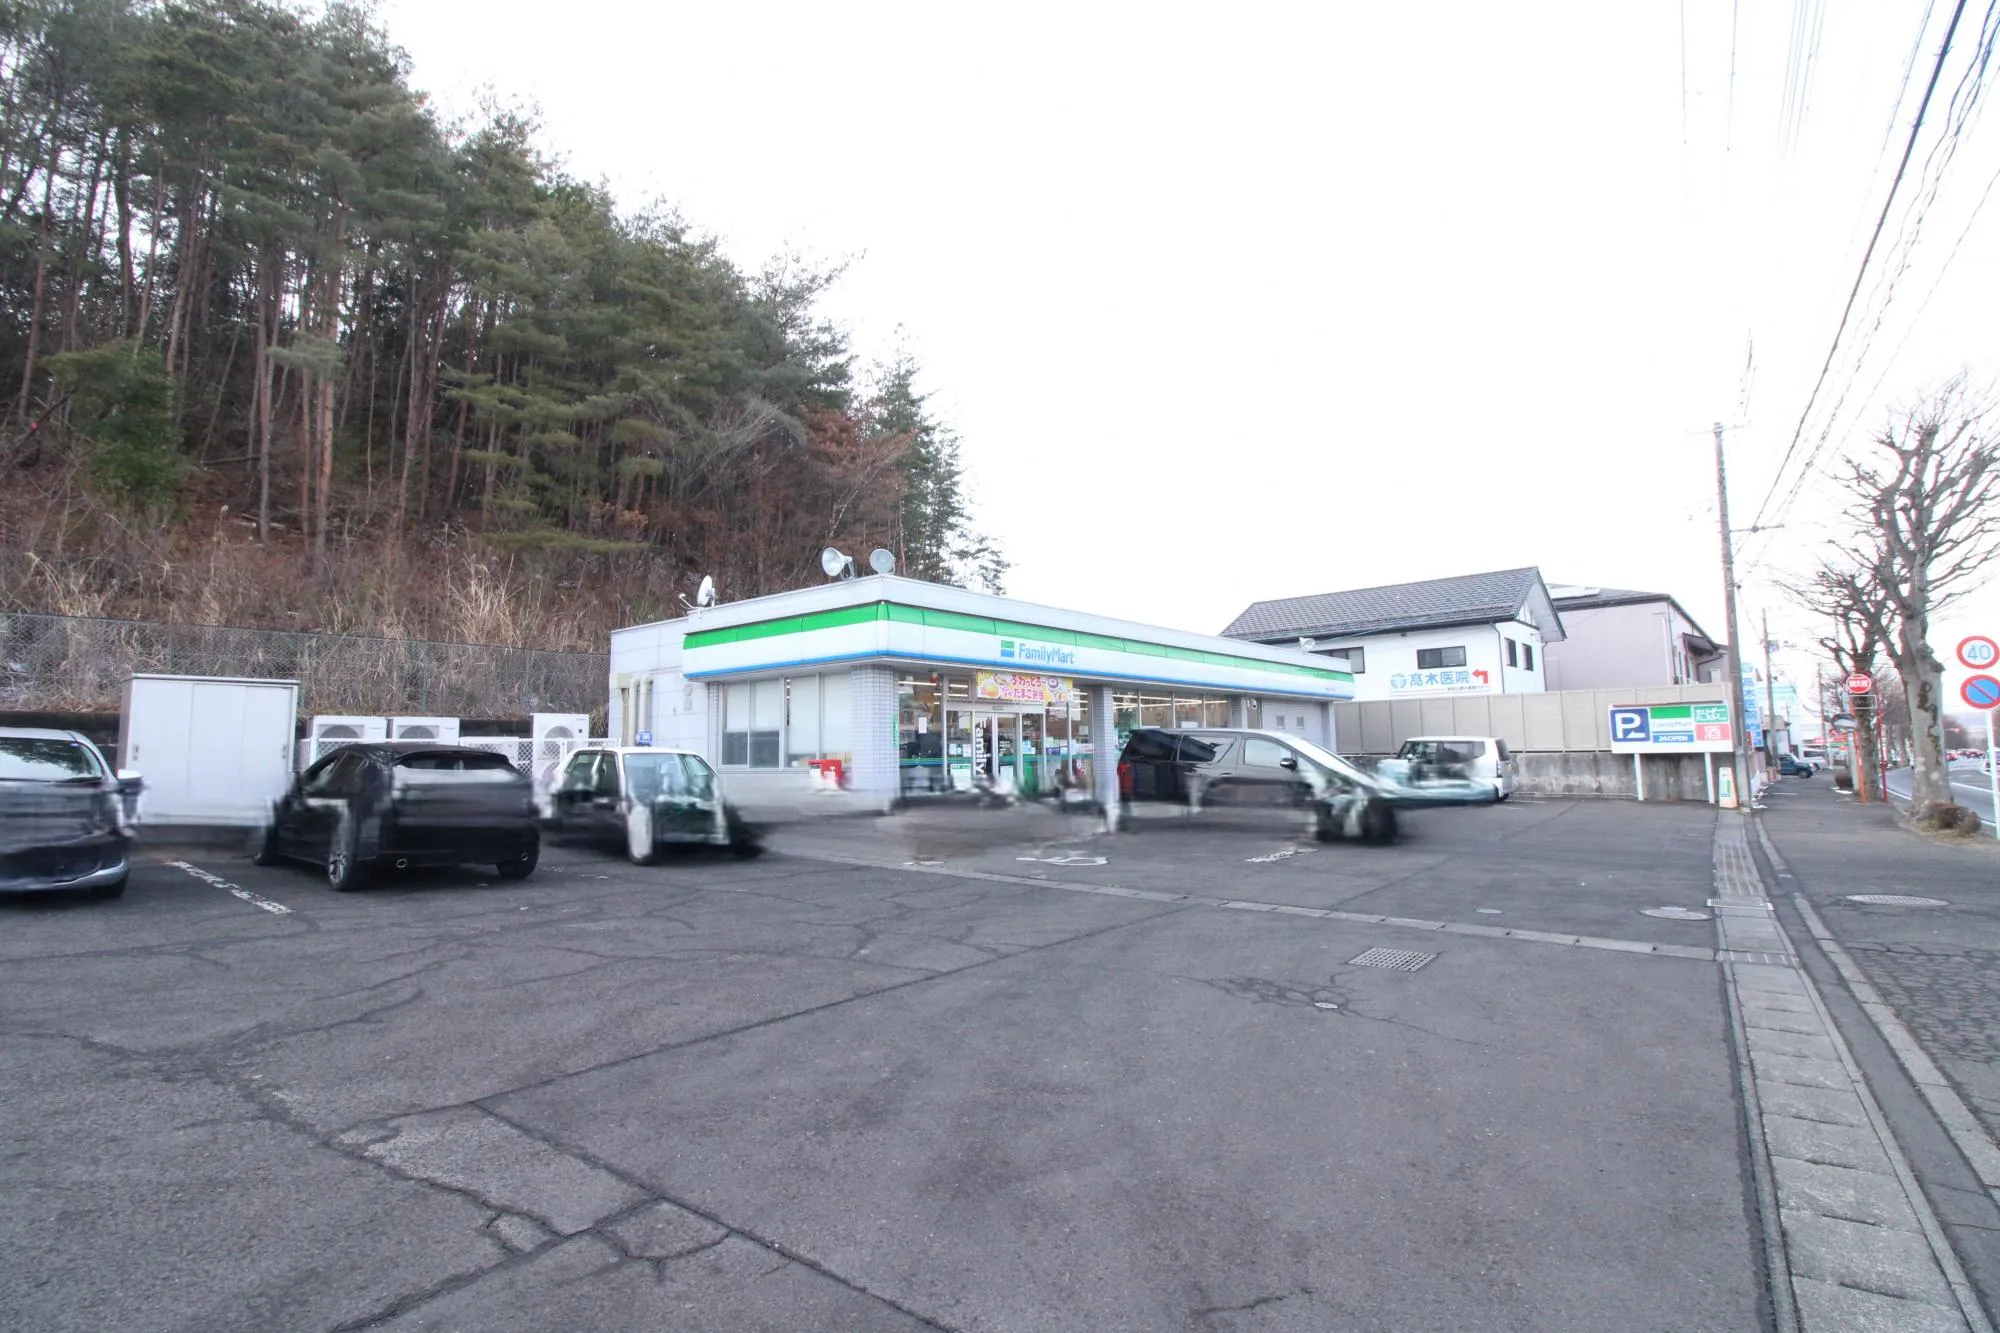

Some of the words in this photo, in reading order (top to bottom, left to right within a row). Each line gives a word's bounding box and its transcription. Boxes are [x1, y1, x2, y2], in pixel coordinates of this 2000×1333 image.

[1019, 643, 1074, 664] FamilyMart
[1967, 644, 1990, 660] 40
[1696, 707, 1727, 721] たばこ
[1614, 713, 1641, 739] P
[1653, 720, 1691, 728] FamilyMart
[1704, 725, 1721, 740] 酒
